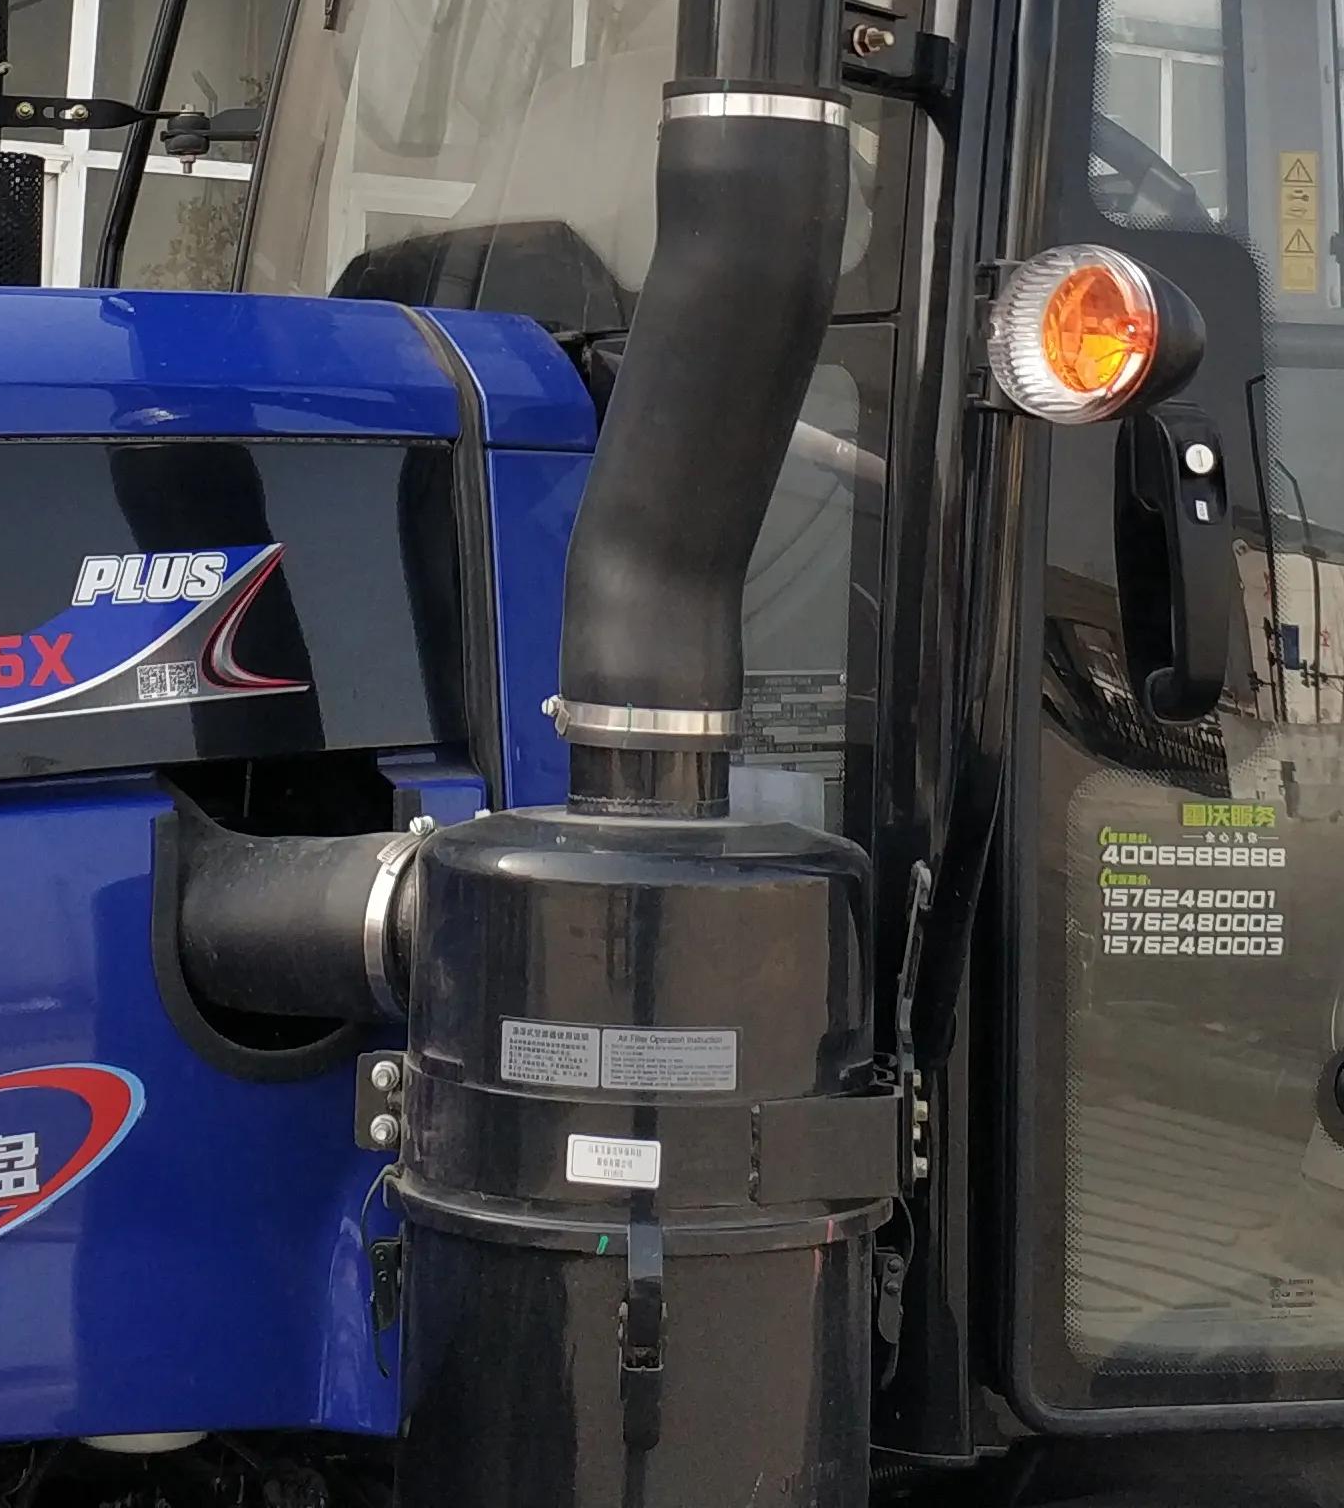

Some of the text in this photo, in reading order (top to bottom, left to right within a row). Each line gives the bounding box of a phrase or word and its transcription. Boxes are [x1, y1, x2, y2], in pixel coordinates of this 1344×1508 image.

[72, 552, 229, 606] PLUS
[1182, 804, 1276, 827] 雷沃服务
[1102, 845, 1286, 867] 4006589888
[1103, 888, 1275, 909] 15762480001
[1103, 912, 1284, 932] 15762480002
[1103, 935, 1284, 955] 15762480003
